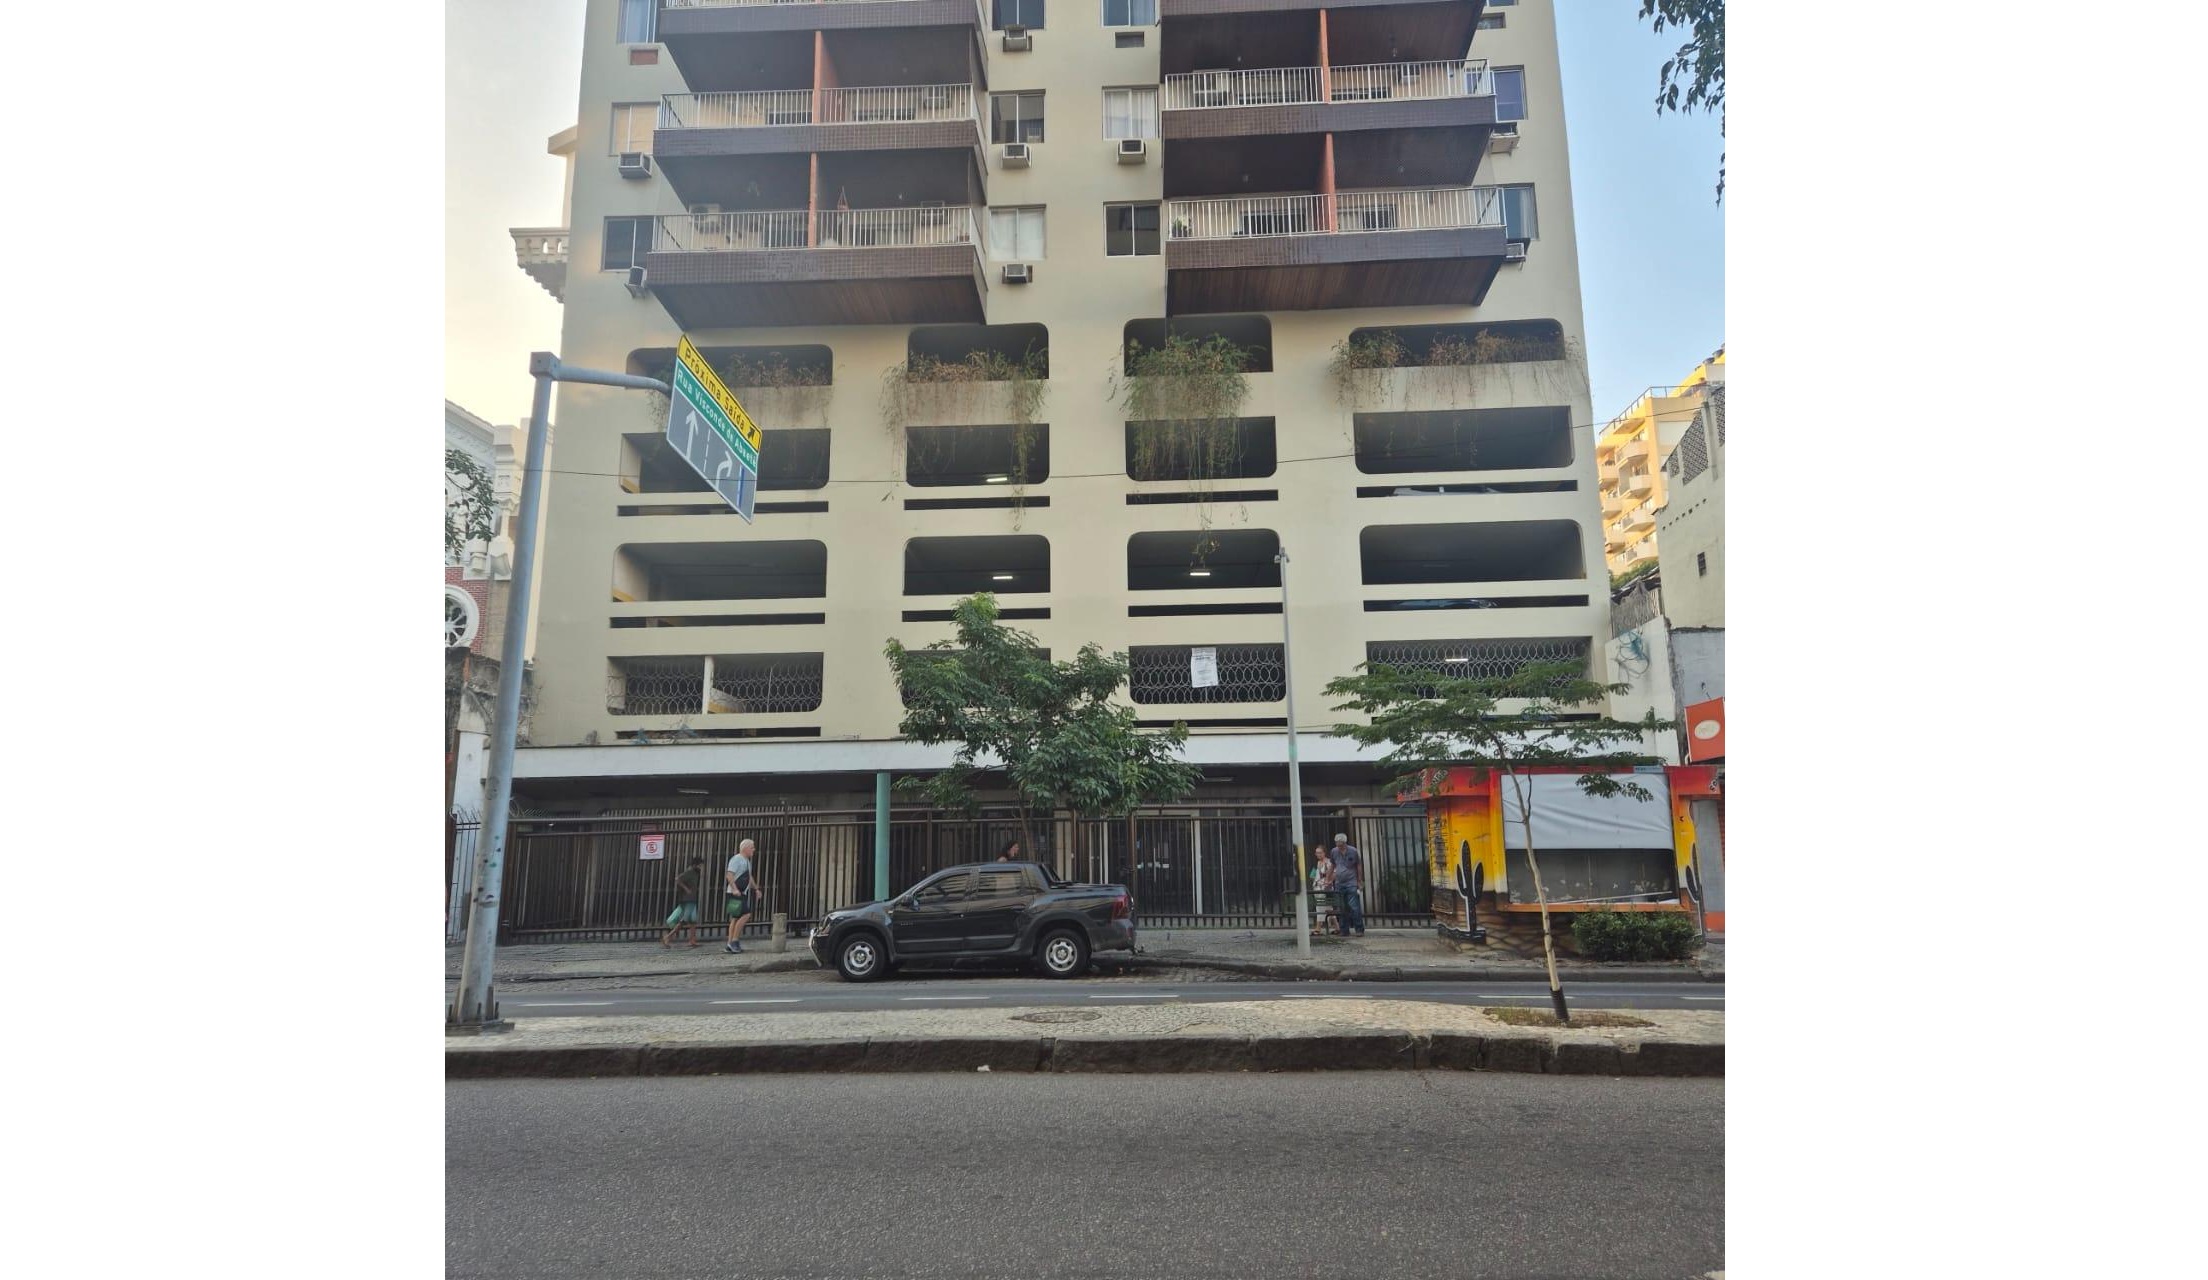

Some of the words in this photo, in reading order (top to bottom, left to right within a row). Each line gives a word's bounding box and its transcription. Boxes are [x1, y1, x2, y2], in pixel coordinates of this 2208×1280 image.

[677, 369, 693, 395] Rua
[695, 388, 726, 432] Visconde
[726, 429, 734, 442] de
[685, 347, 721, 401] Próxima
[724, 396, 745, 430] Saída
